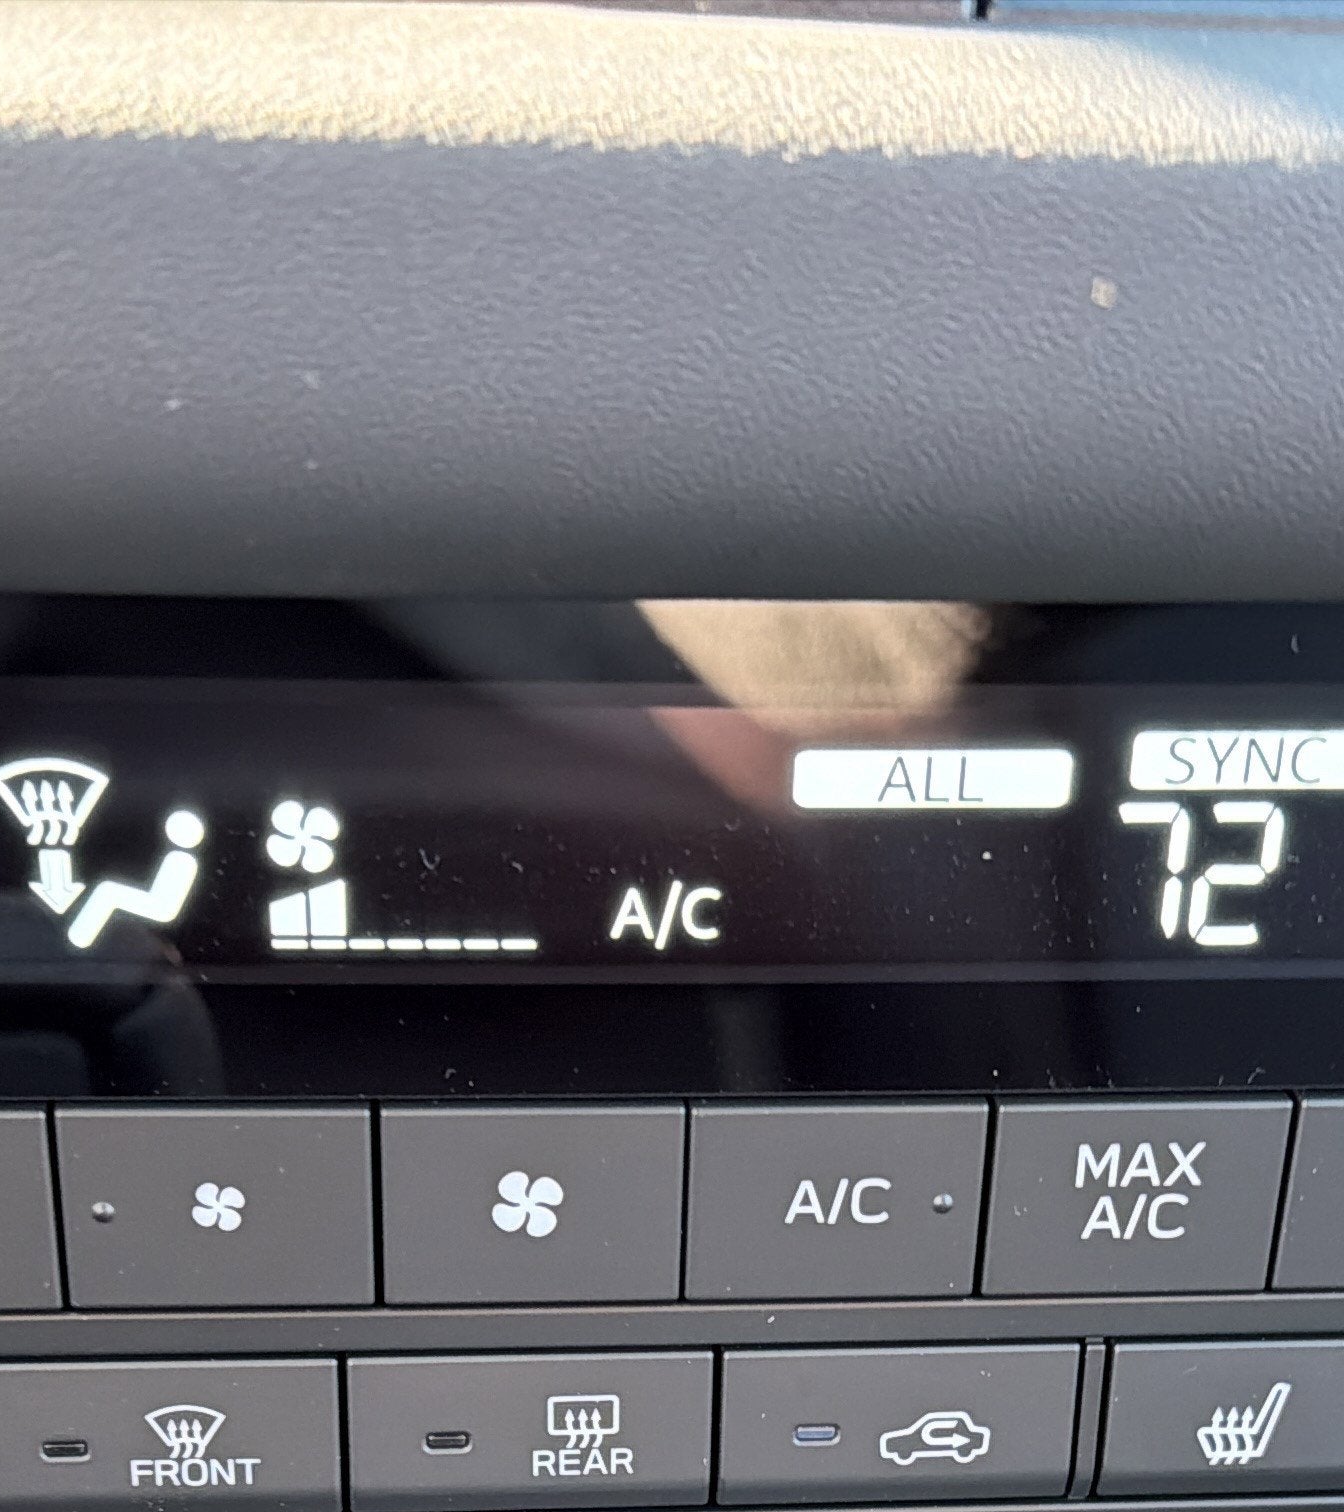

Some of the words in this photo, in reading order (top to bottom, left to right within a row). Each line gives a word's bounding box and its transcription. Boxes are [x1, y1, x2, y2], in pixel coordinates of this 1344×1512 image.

[875, 753, 985, 805] ALL
[1163, 735, 1329, 787] SYNC
[1117, 799, 1287, 948] 72
[608, 878, 723, 952] A/C
[1074, 1140, 1207, 1190] MAX
[783, 1176, 893, 1226] A/C
[1079, 1191, 1190, 1241] A/C
[129, 1457, 263, 1488] FRONT
[531, 1448, 635, 1478] REAR
